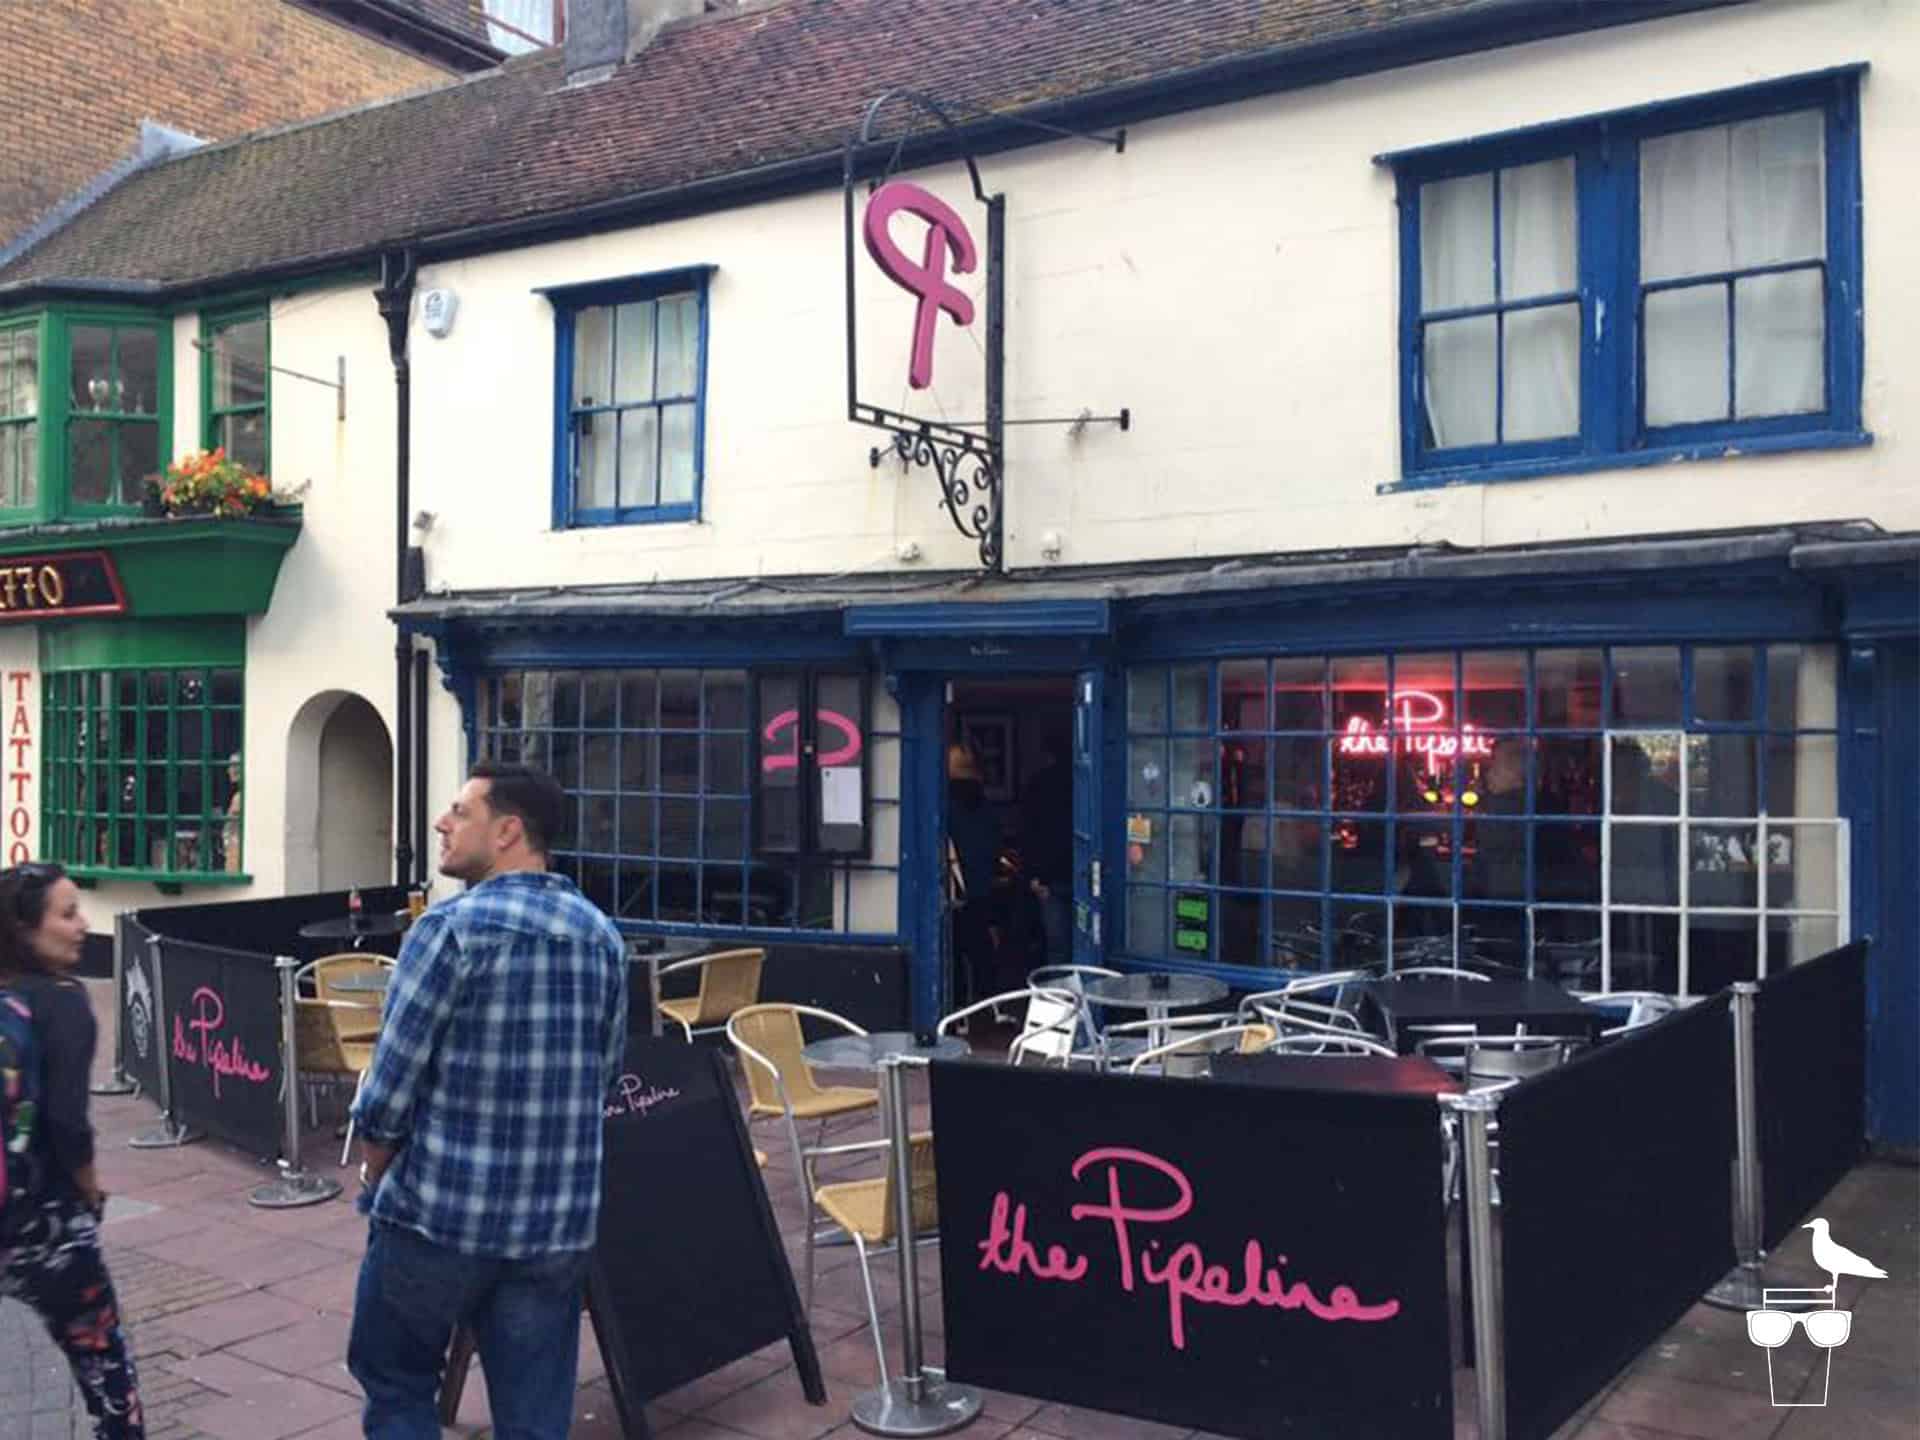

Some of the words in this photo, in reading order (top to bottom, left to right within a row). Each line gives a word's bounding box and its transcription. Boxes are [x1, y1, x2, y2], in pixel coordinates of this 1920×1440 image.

[0, 566, 63, 608] 770
[8, 672, 31, 867] TATTOO
[190, 986, 270, 1099] Pipeline
[979, 1192, 1088, 1281] the
[1071, 1148, 1399, 1349] Pipeline
